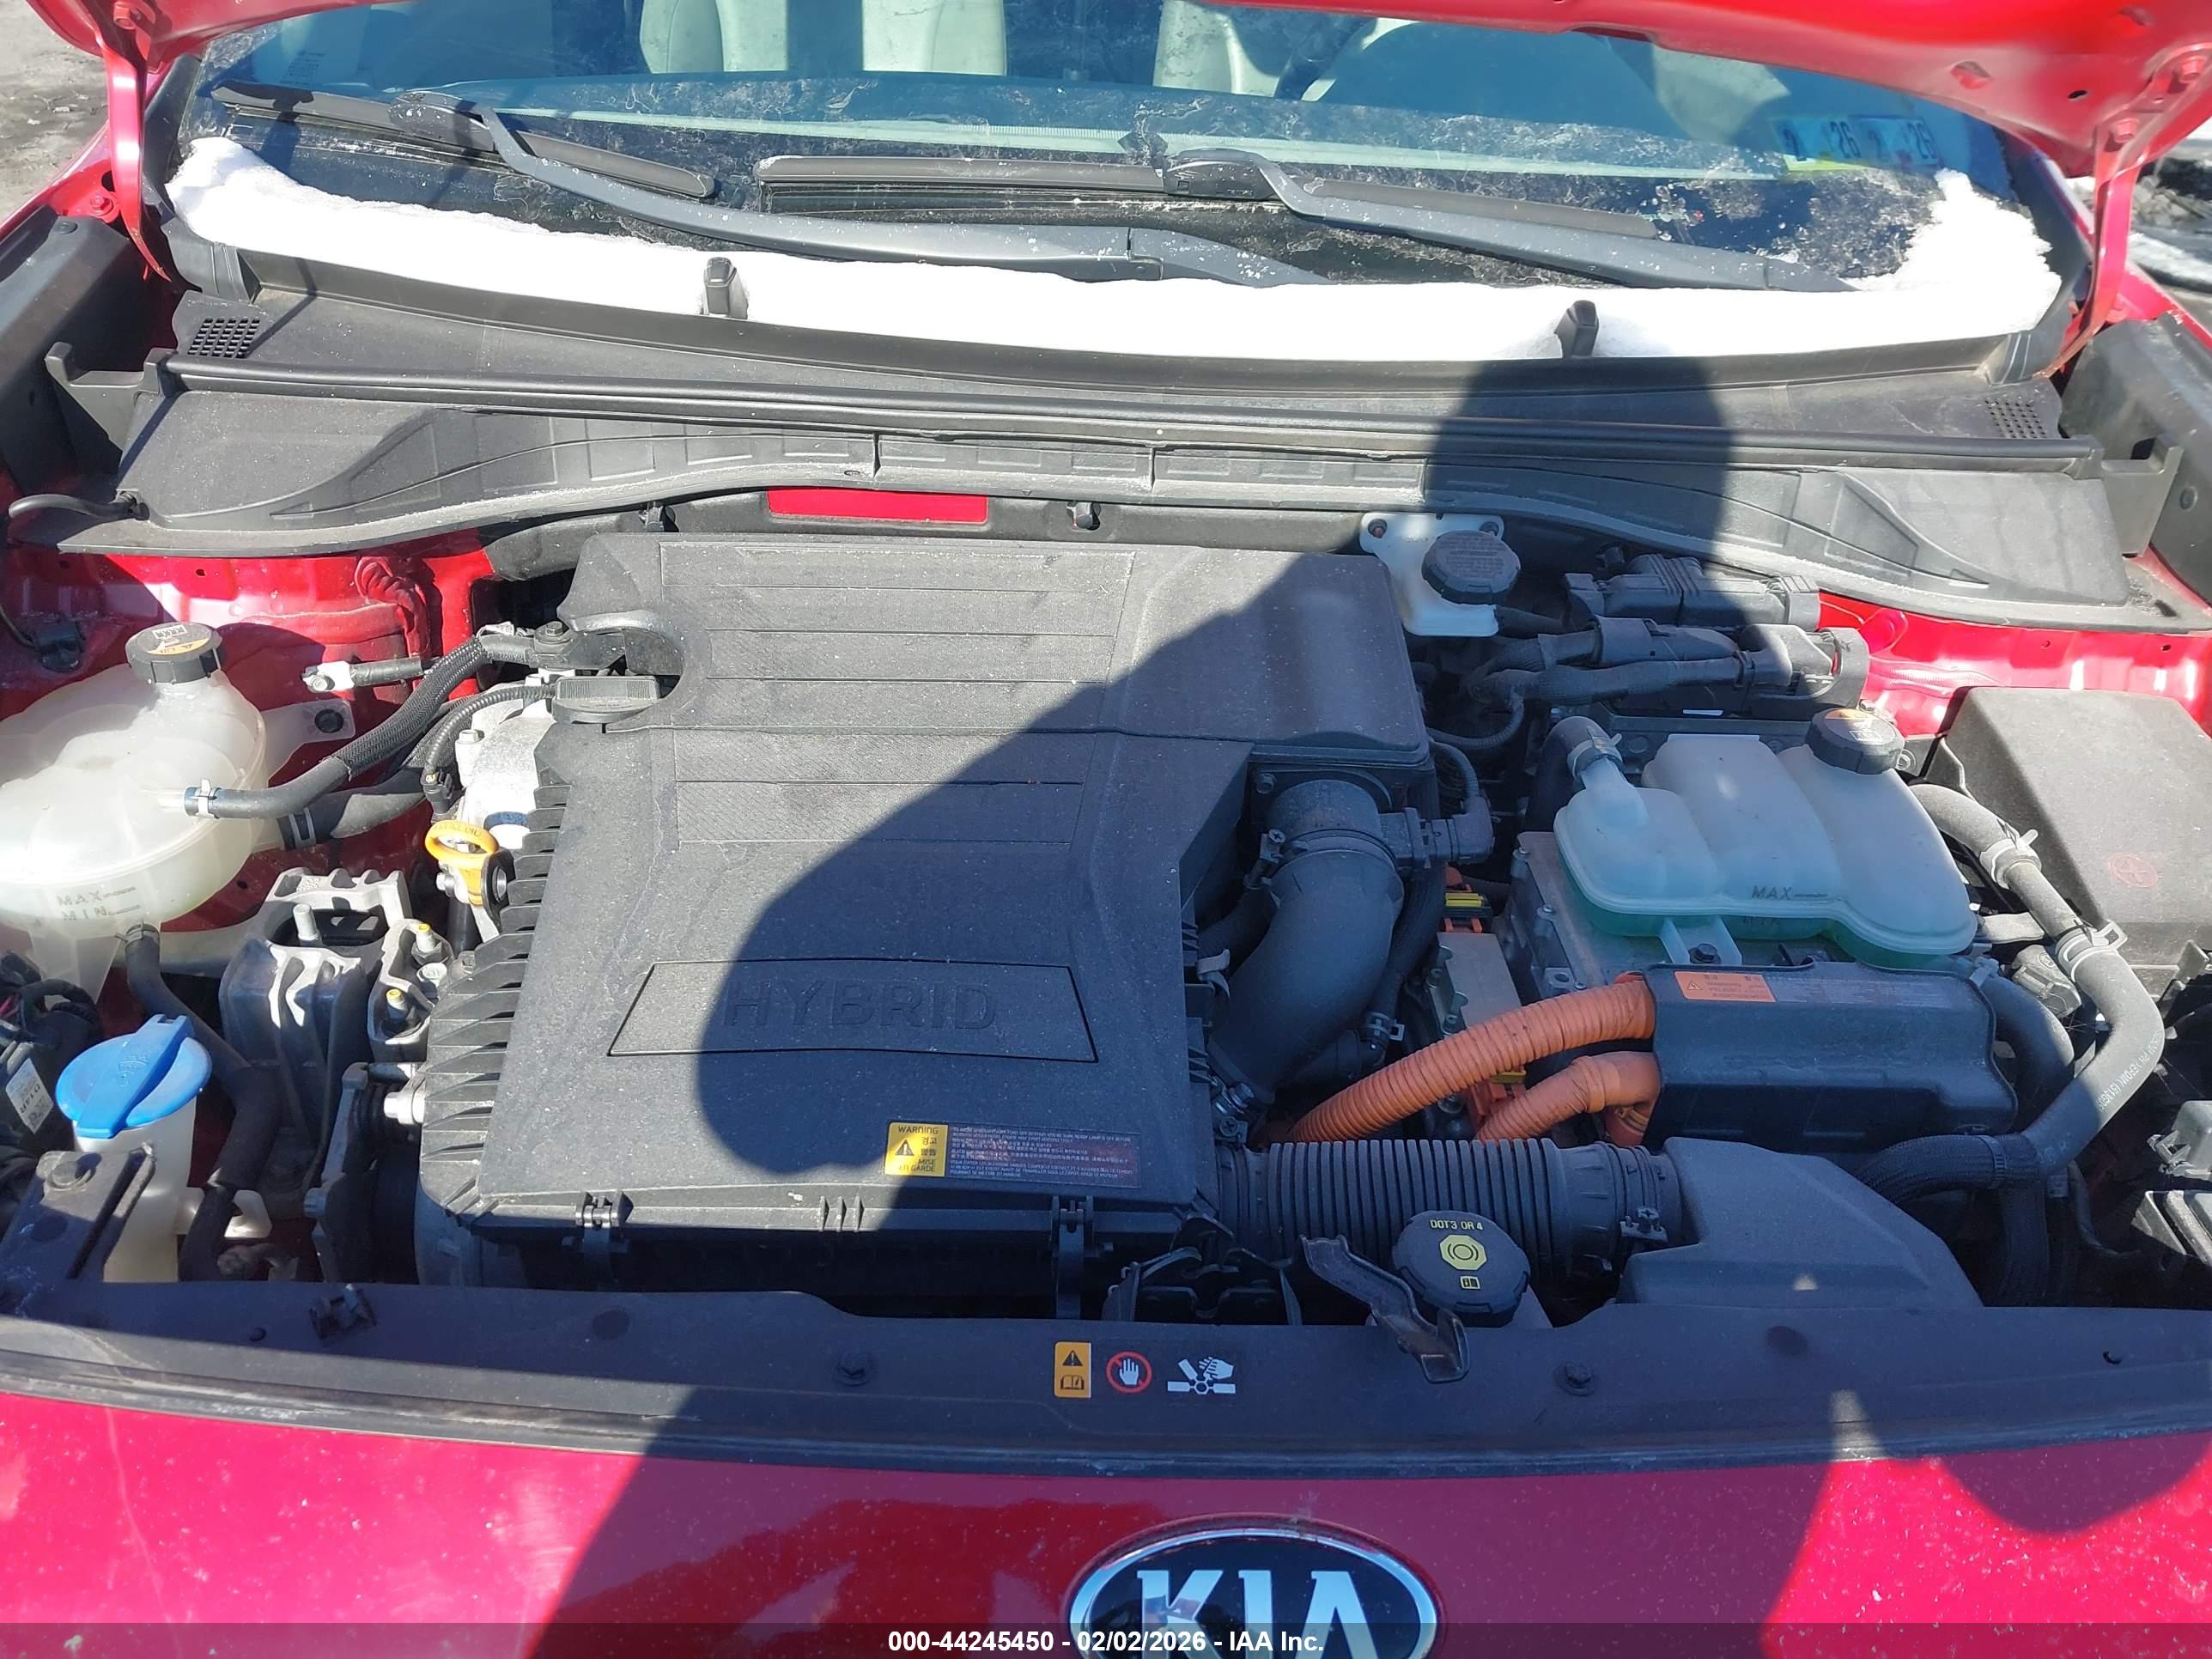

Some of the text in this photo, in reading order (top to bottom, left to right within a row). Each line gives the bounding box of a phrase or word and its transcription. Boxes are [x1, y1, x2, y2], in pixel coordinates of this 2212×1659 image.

[56, 890, 103, 906] MAX
[1752, 885, 1792, 901] MAX
[723, 980, 998, 1030] HYBRID
[1430, 1219, 1483, 1231] DOT3 OR 4
[1136, 1569, 1380, 1658] KIA
